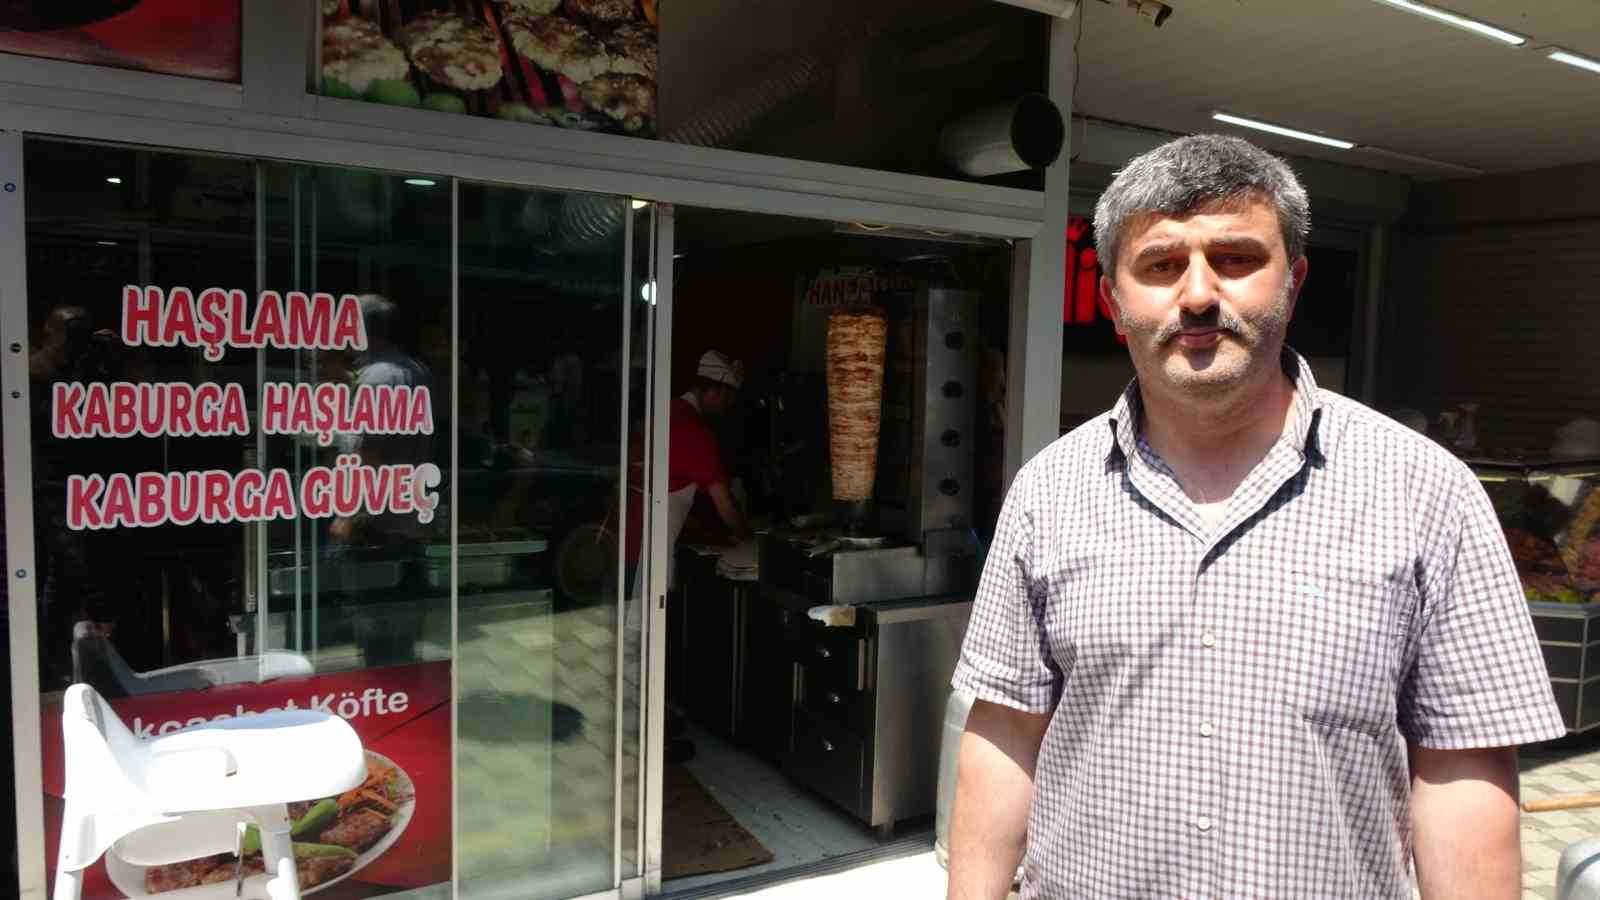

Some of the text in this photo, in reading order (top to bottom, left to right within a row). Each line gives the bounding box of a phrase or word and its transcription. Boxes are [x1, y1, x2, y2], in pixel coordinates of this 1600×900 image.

[122, 286, 367, 361] HAŞLAMA
[53, 382, 434, 445] KABURGA HAŞLAMA
[67, 454, 441, 530] KABURGA GÜVEÇ
[311, 687, 409, 719] Köfte
